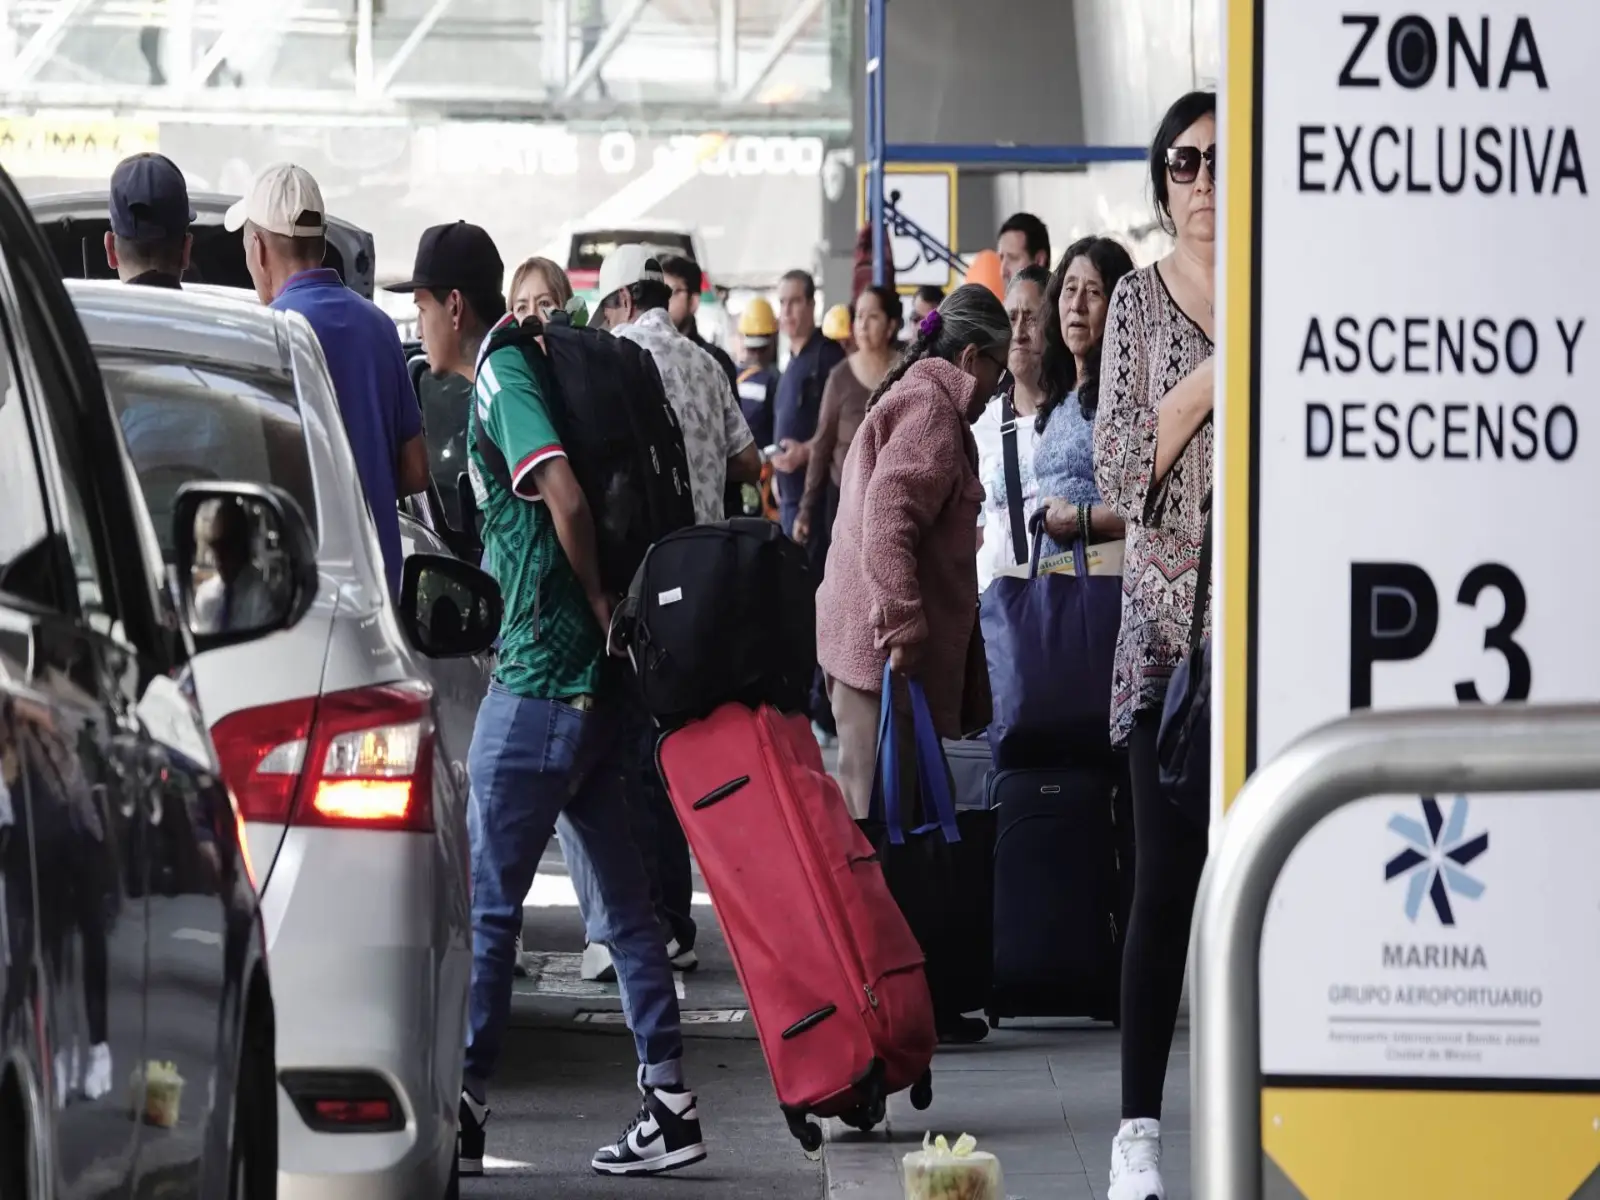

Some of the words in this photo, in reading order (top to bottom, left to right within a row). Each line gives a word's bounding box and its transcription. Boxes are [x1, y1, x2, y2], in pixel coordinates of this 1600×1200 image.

[1338, 15, 1548, 90] ZONA
[1298, 125, 1588, 195] EXCLUSIVA
[1297, 316, 1538, 375] ASCENSO
[1556, 318, 1585, 375] Y
[1305, 403, 1578, 462] DESCENSO
[1349, 561, 1532, 711] P3
[1381, 944, 1488, 970] MARINA
[1327, 985, 1391, 1006] GRUPO
[1395, 985, 1543, 1008] AEROPORTUARIO
